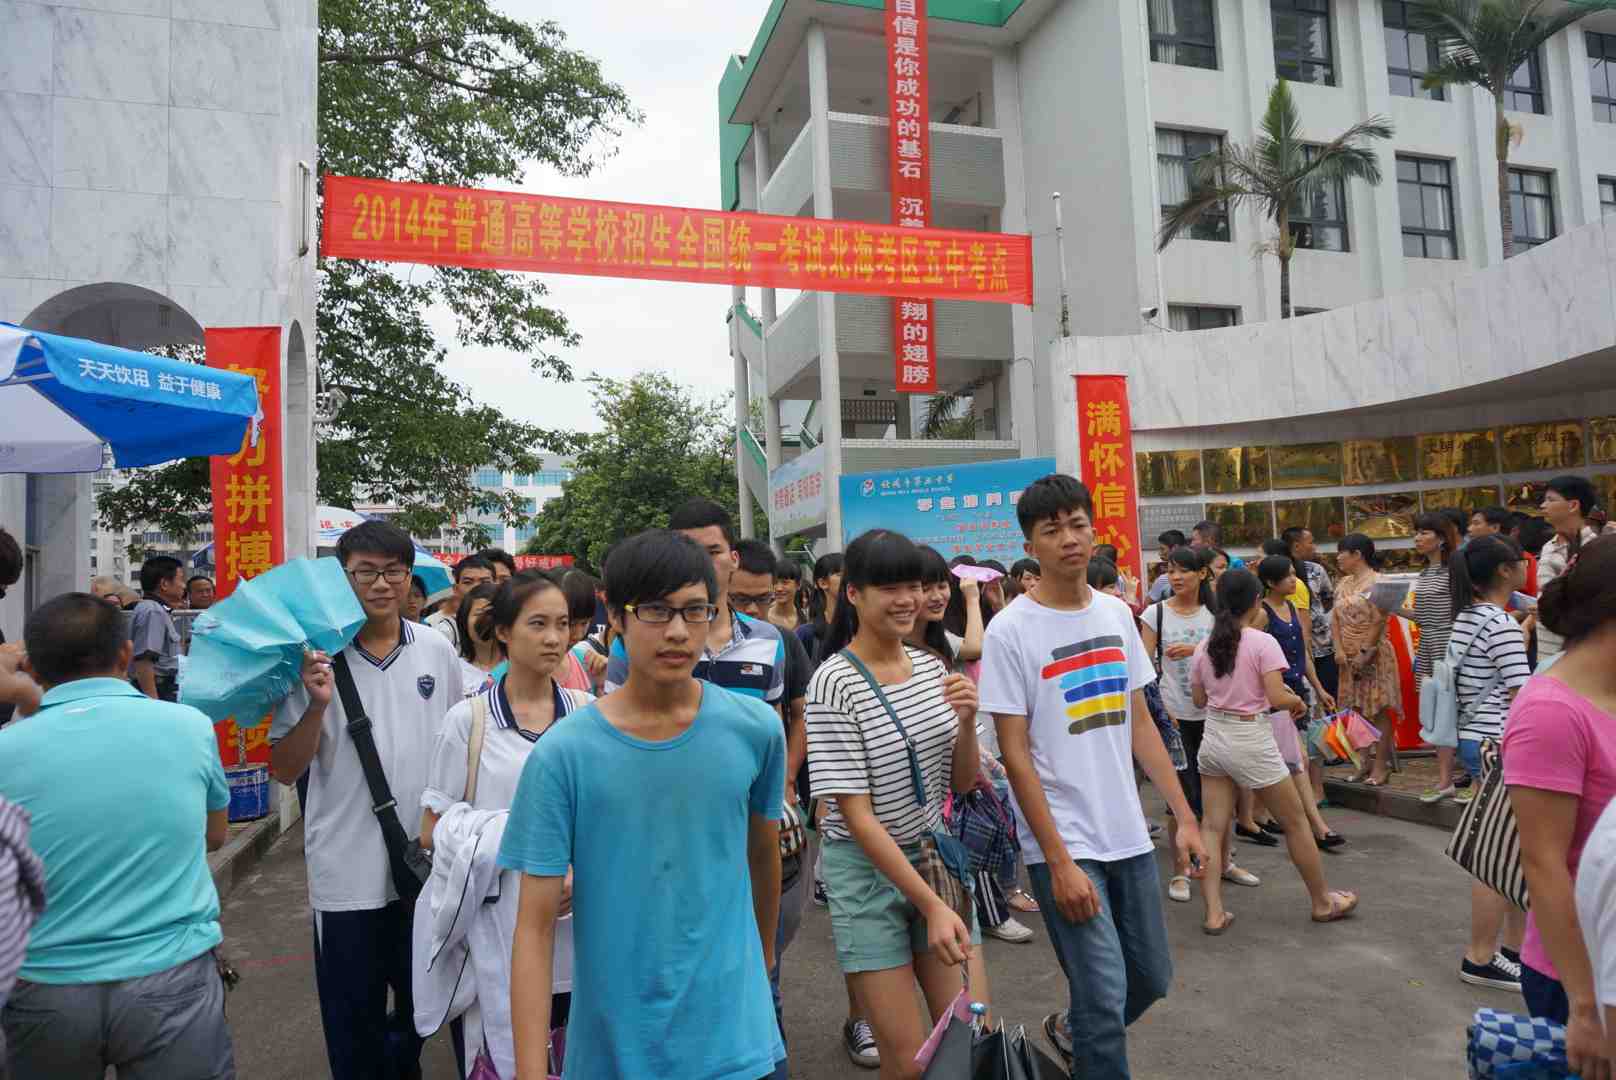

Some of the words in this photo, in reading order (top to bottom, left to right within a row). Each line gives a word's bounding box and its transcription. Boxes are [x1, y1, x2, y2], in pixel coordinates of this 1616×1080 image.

[893, 0, 921, 179] 自信是你成功的基石
[351, 192, 1009, 292] 2014年普通高等学校招生全国统一考试北海考区五中考点
[78, 357, 150, 388] 天天饮用
[157, 371, 223, 400] 益于健康
[224, 364, 272, 580] 力拼搏
[1086, 400, 1133, 578] 满怀信心
